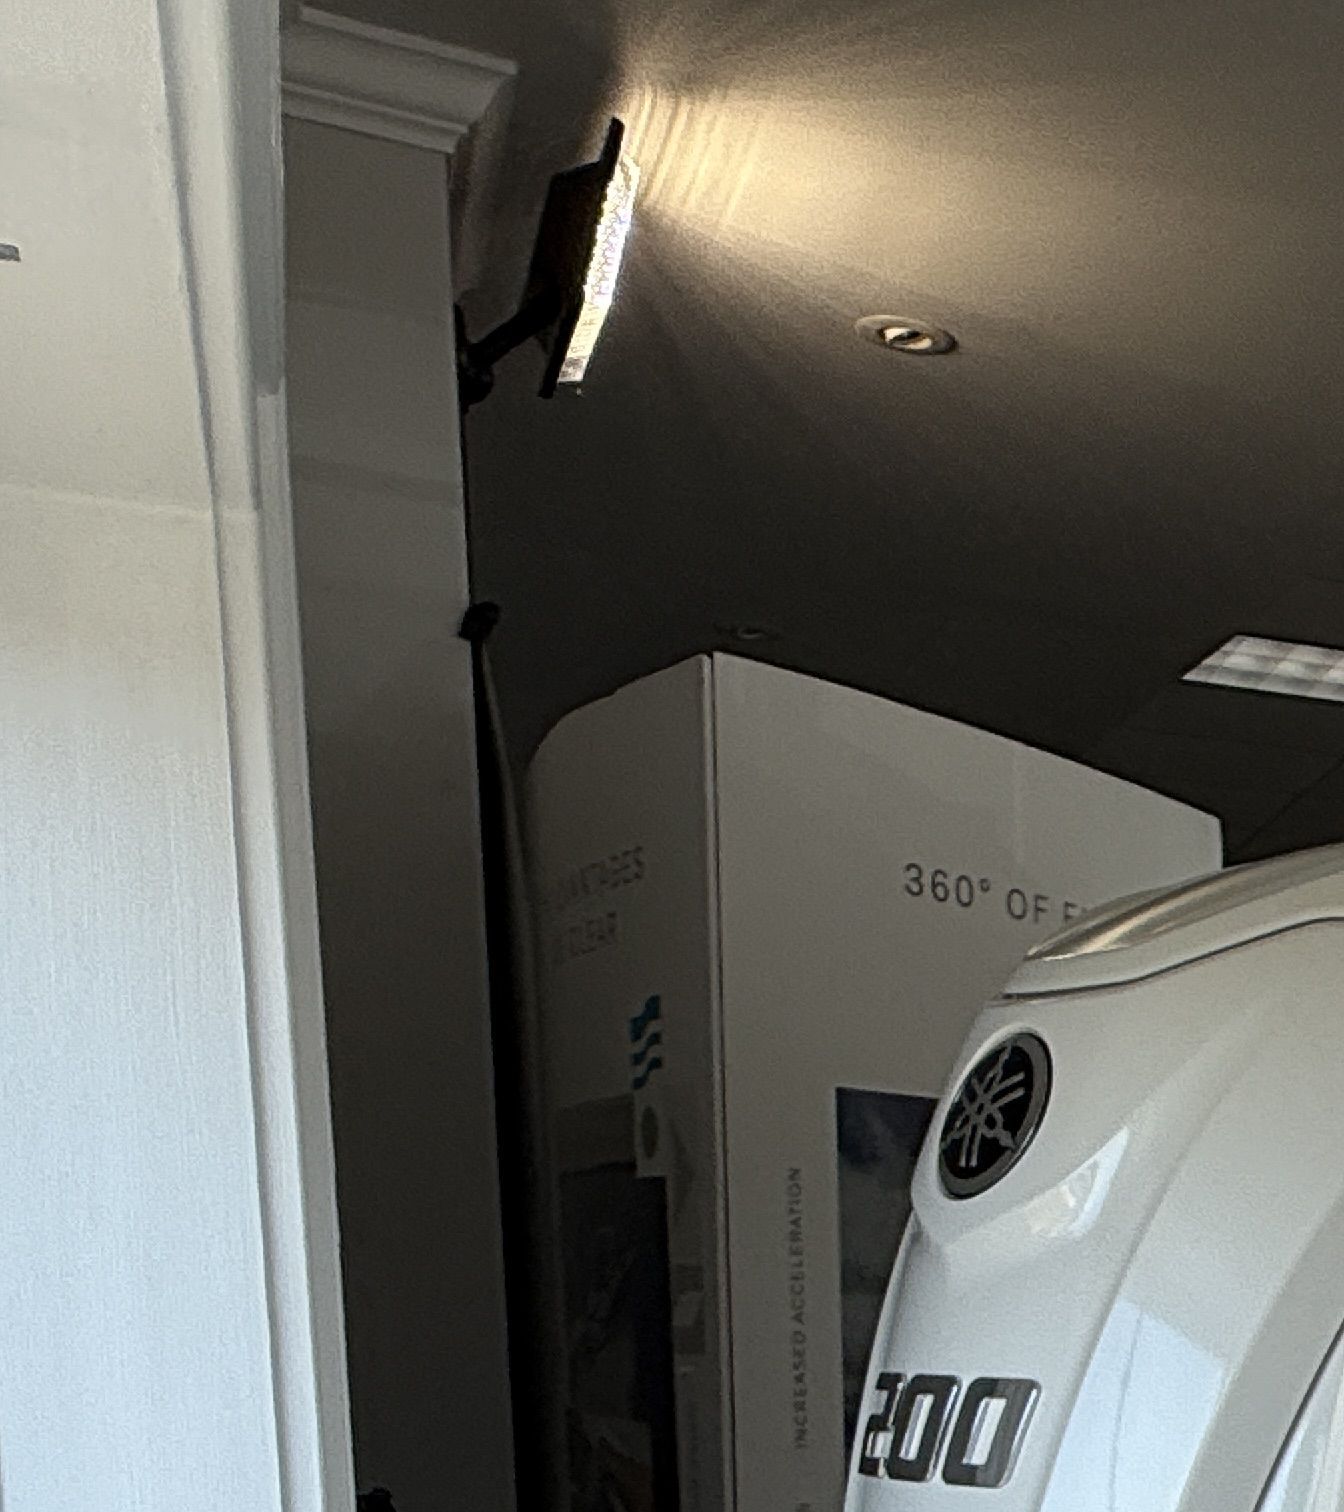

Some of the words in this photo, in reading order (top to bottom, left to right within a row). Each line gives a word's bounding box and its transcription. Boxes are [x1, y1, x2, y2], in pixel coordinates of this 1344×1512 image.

[904, 863, 990, 907] 360°
[1007, 888, 1049, 923] OF
[788, 1166, 805, 1326] ACCELERATION
[792, 1329, 808, 1450] INCREASED
[858, 1372, 1042, 1489] 200
